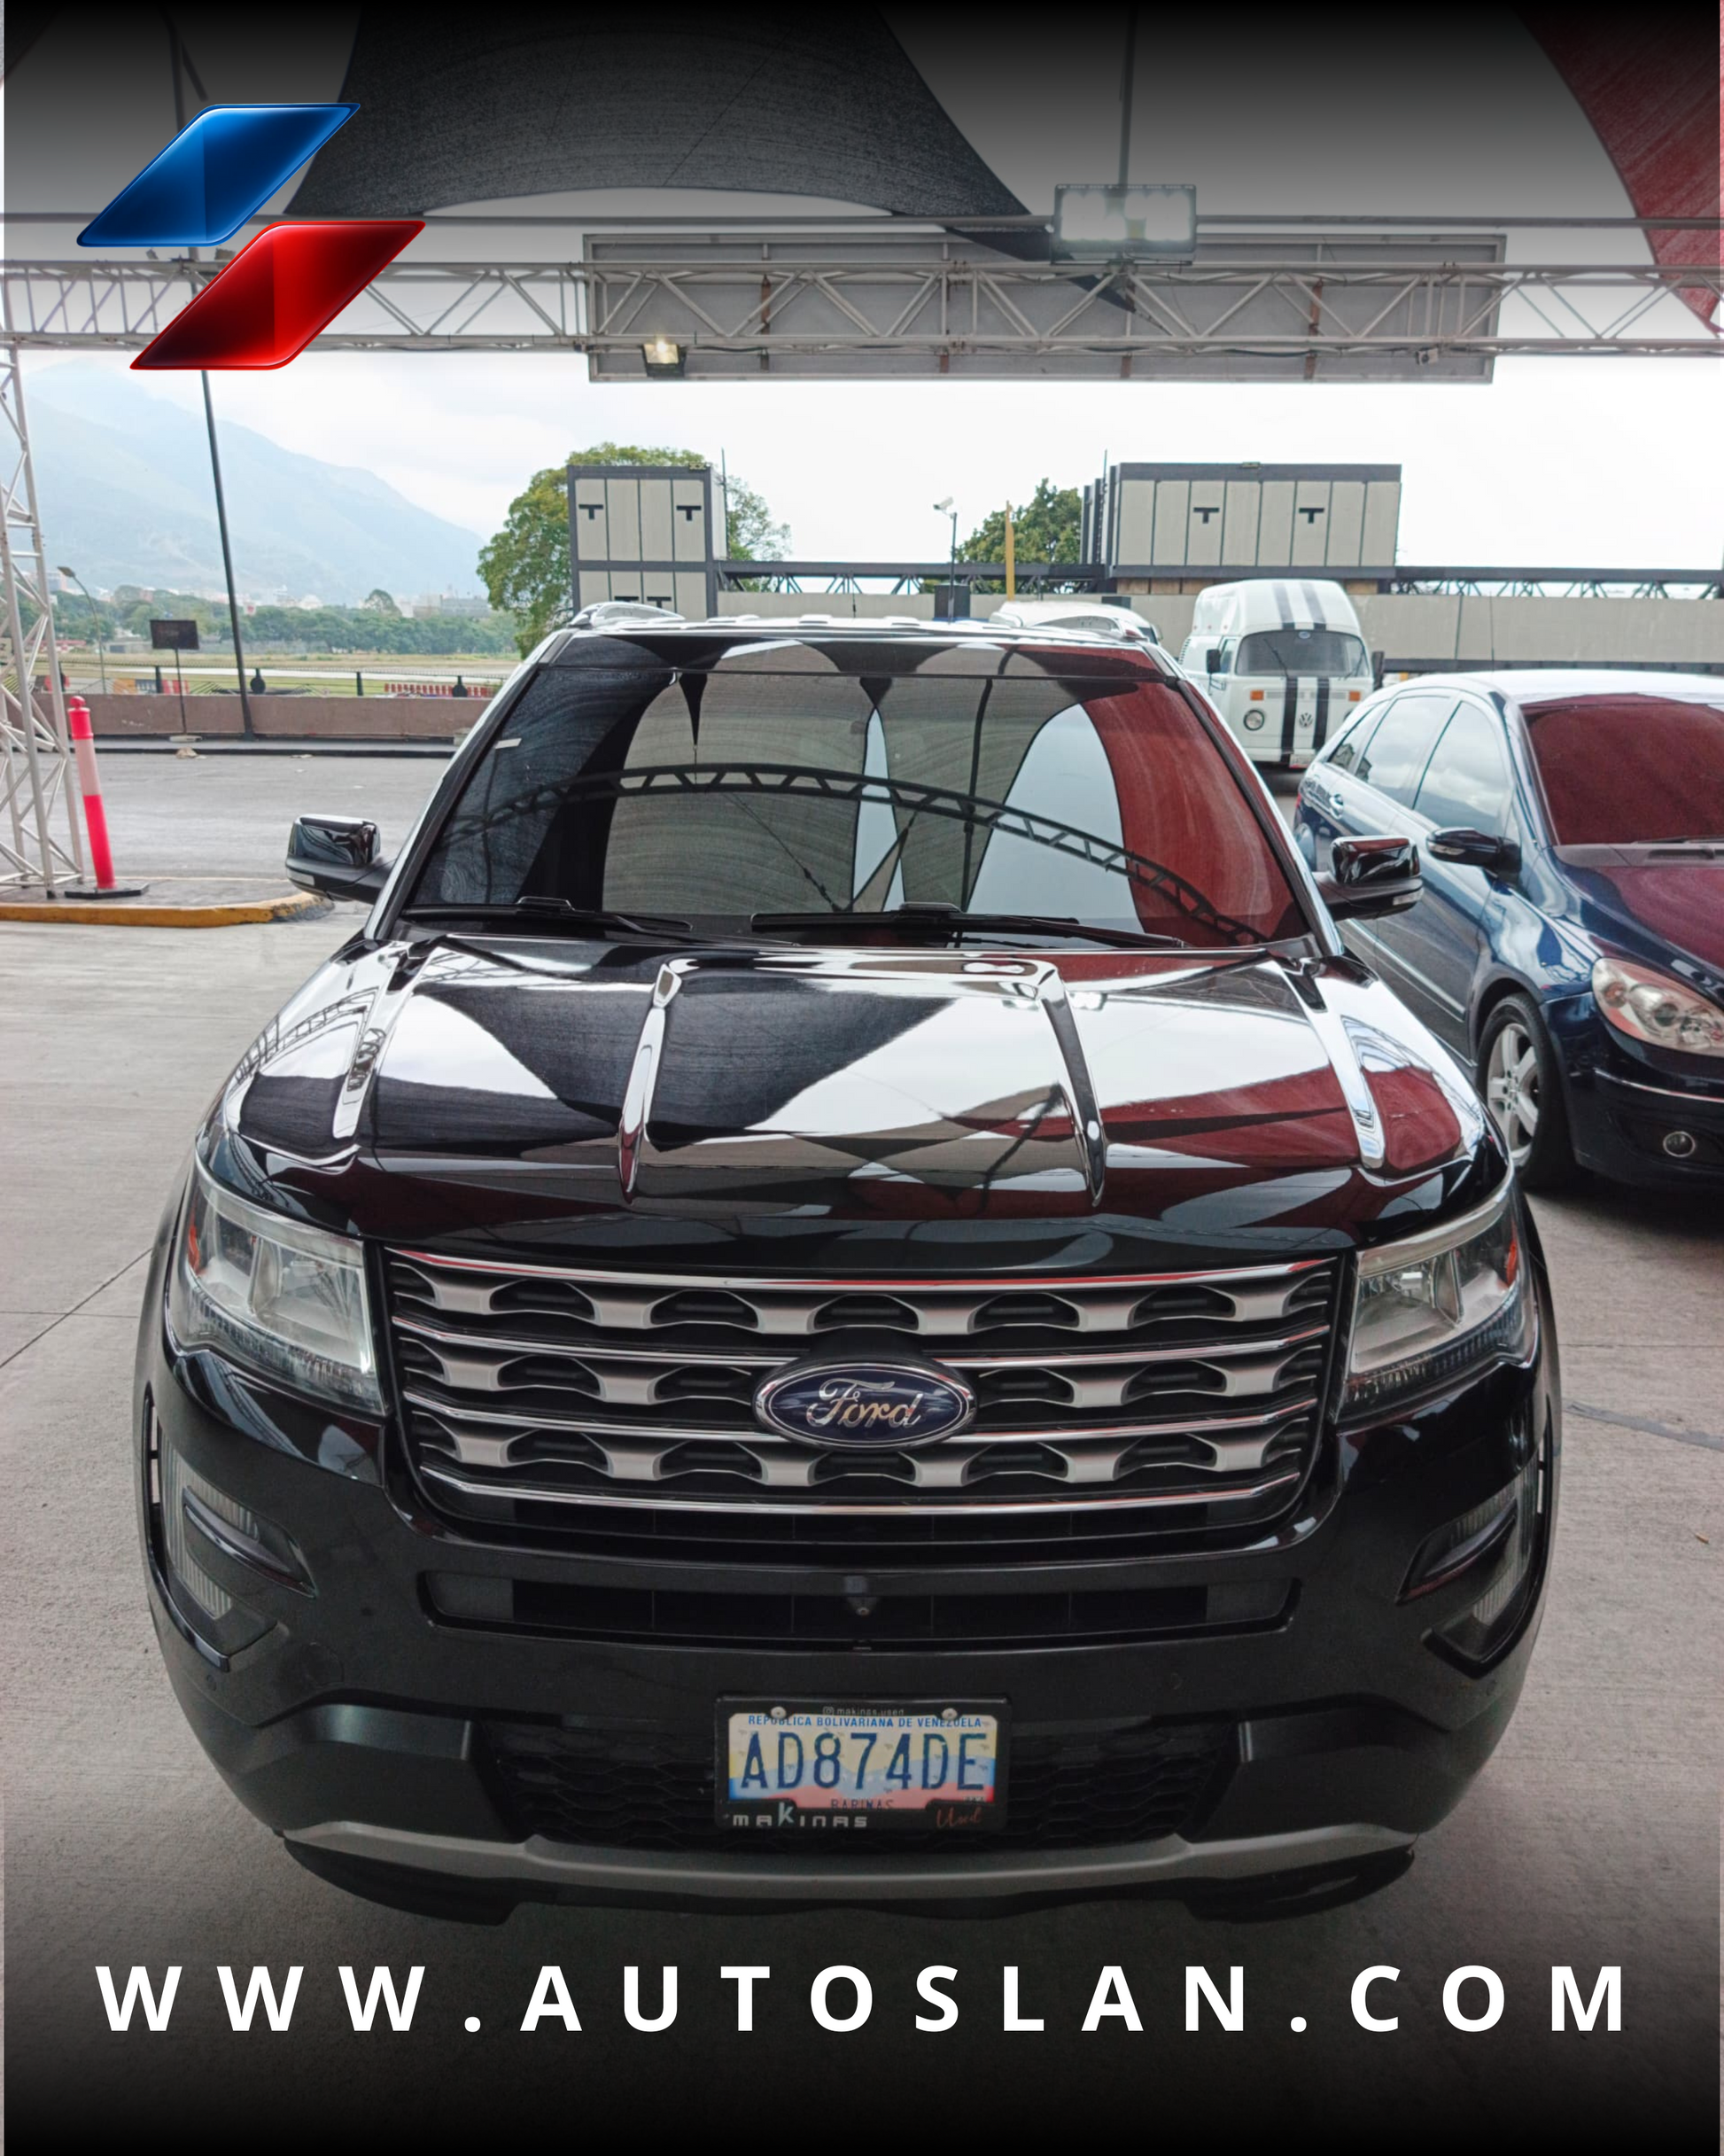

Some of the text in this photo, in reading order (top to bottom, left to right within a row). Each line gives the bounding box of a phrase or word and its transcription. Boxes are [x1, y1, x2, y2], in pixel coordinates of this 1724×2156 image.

[806, 1377, 924, 1428] Ford
[817, 1716, 894, 1727] BOLIVARIANA
[898, 1717, 912, 1727] DE
[917, 1717, 982, 1727] VENEZUELA
[740, 1731, 987, 1790] AD874DE
